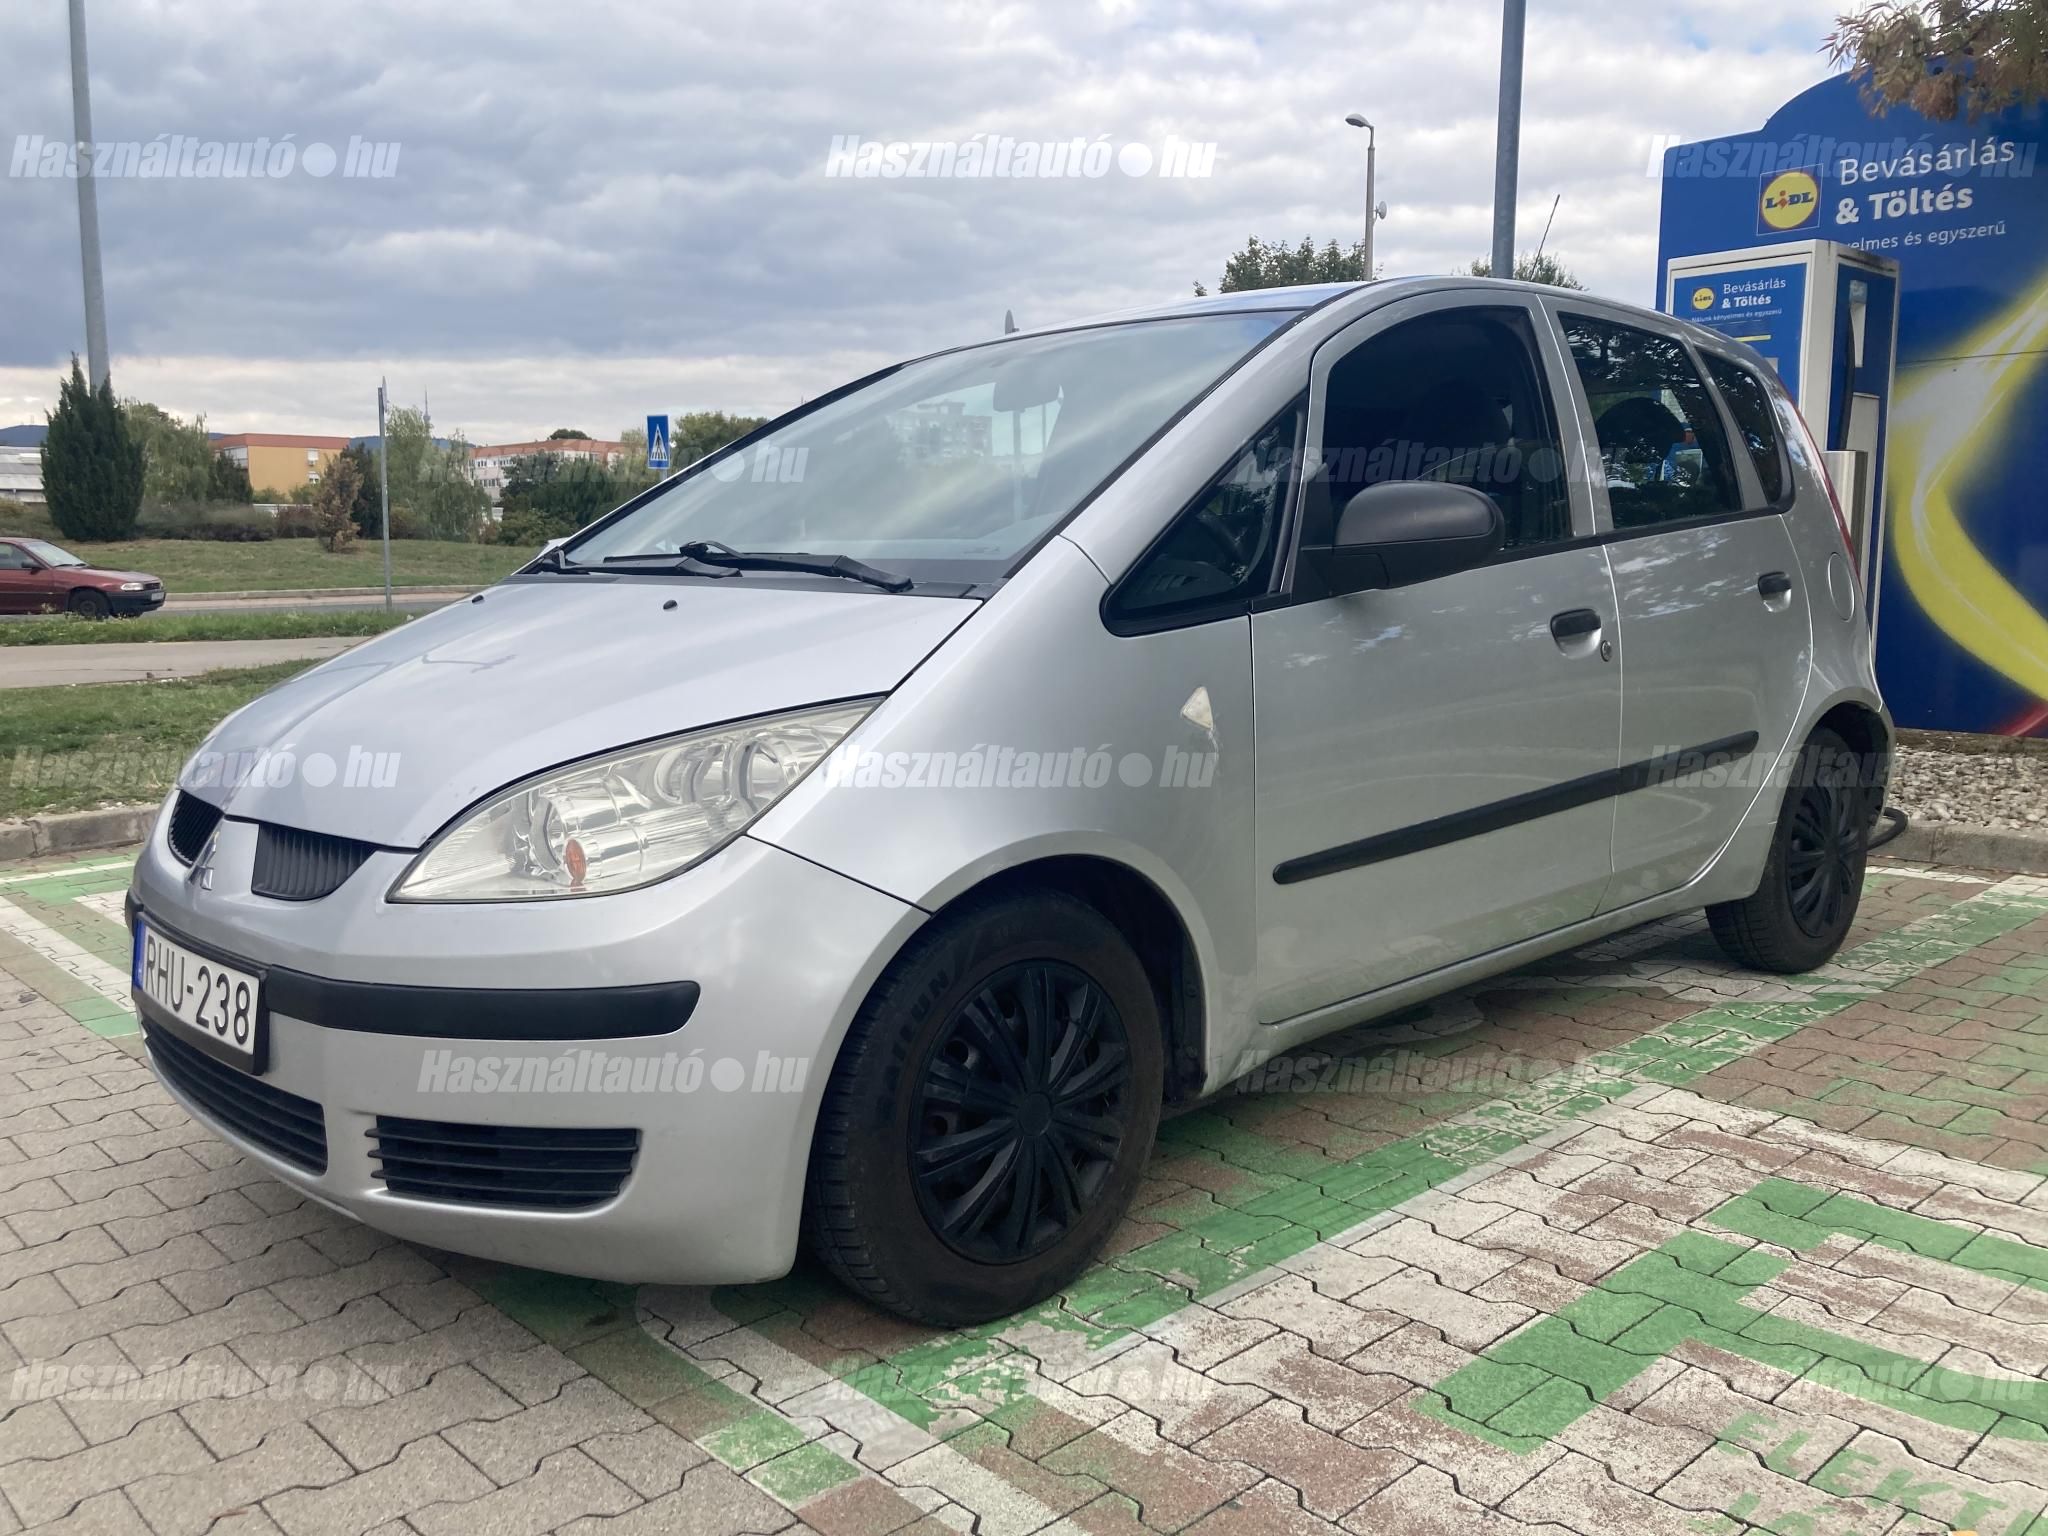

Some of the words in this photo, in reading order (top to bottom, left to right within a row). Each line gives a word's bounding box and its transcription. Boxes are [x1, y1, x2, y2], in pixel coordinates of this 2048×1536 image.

[1839, 136, 2015, 186] Bevásárlás
[1835, 197, 1860, 225] &
[1868, 183, 1974, 220] Töltés
[1847, 236, 1899, 251] elmes
[1904, 231, 1922, 247] és
[1928, 220, 2006, 246] egyszerű
[1722, 298, 1731, 309] &
[1734, 294, 1772, 308] Töltés
[1723, 278, 1786, 294] Bevásárlás
[145, 932, 251, 1046] RHU-238
